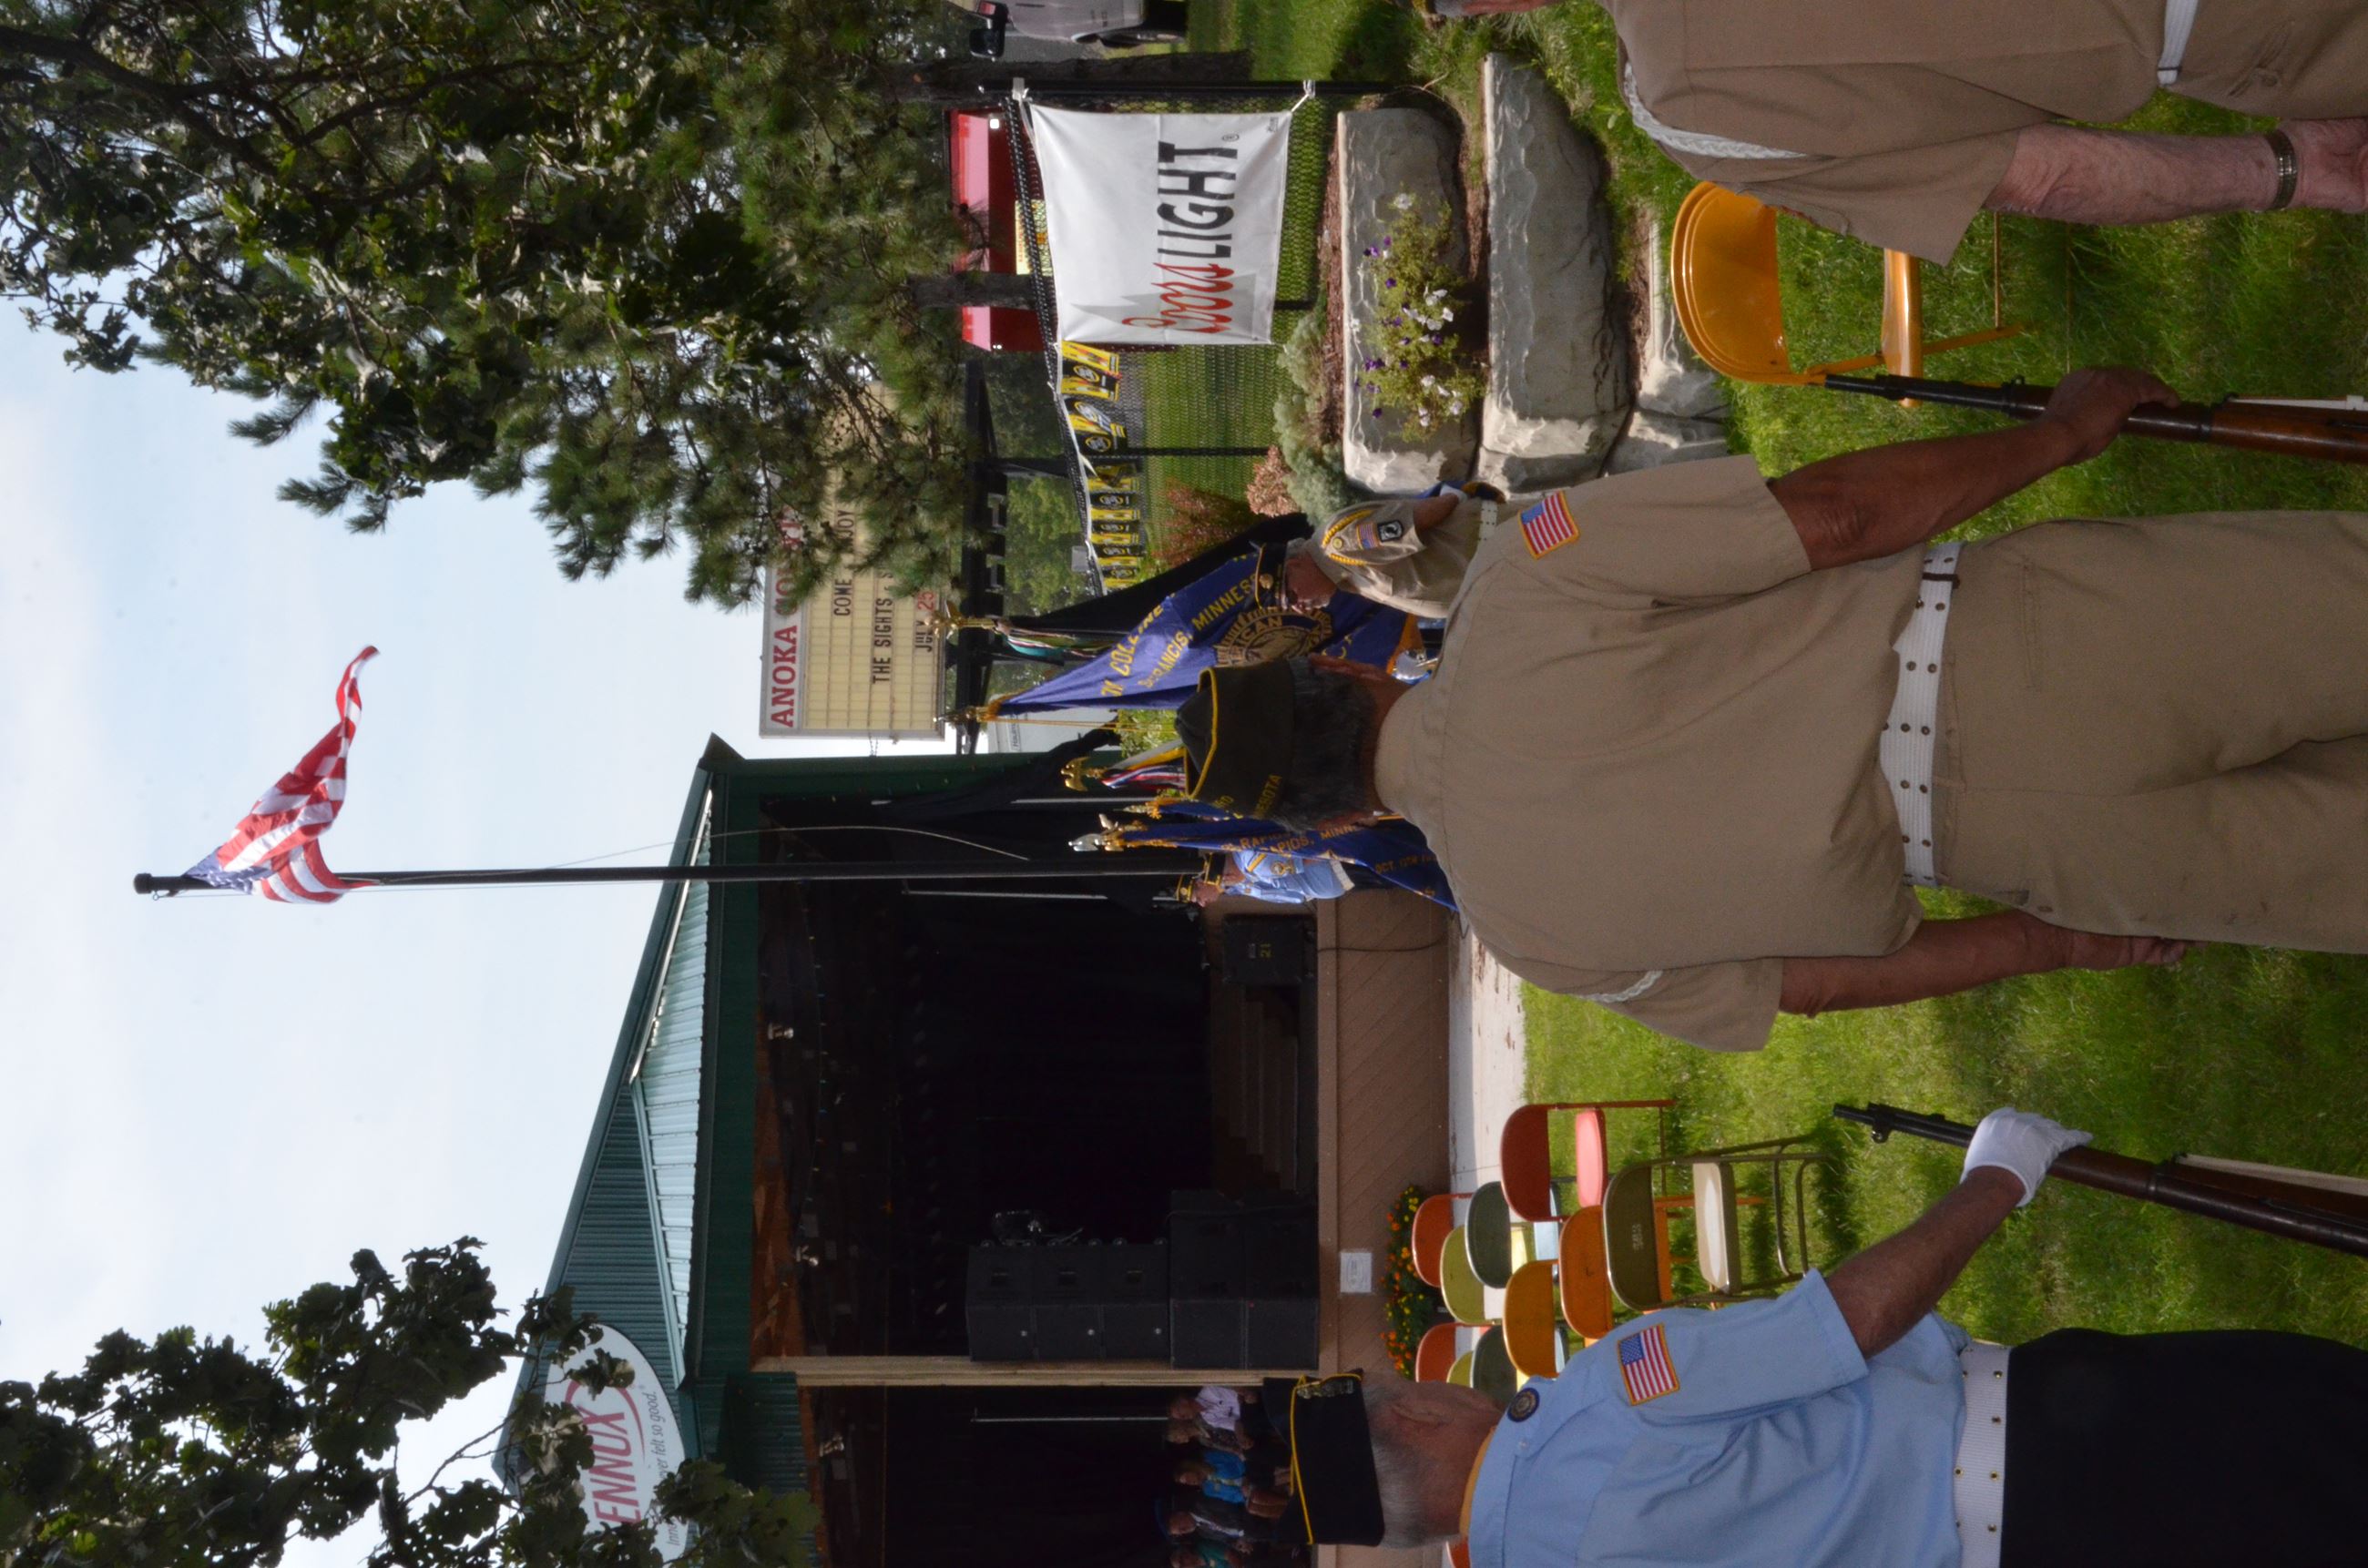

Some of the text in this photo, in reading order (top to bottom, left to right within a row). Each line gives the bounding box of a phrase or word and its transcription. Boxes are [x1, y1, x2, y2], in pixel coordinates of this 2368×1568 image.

[1121, 140, 1238, 334] Coors LIGHT
[833, 509, 855, 616] COME NJOY
[873, 597, 893, 647] SIGHTS
[771, 625, 798, 728] ANOKA
[873, 657, 892, 684] THE
[649, 1439, 667, 1456] felt
[651, 1424, 664, 1437] so
[577, 1405, 642, 1526] ENNOX
[655, 1458, 670, 1480] ever
